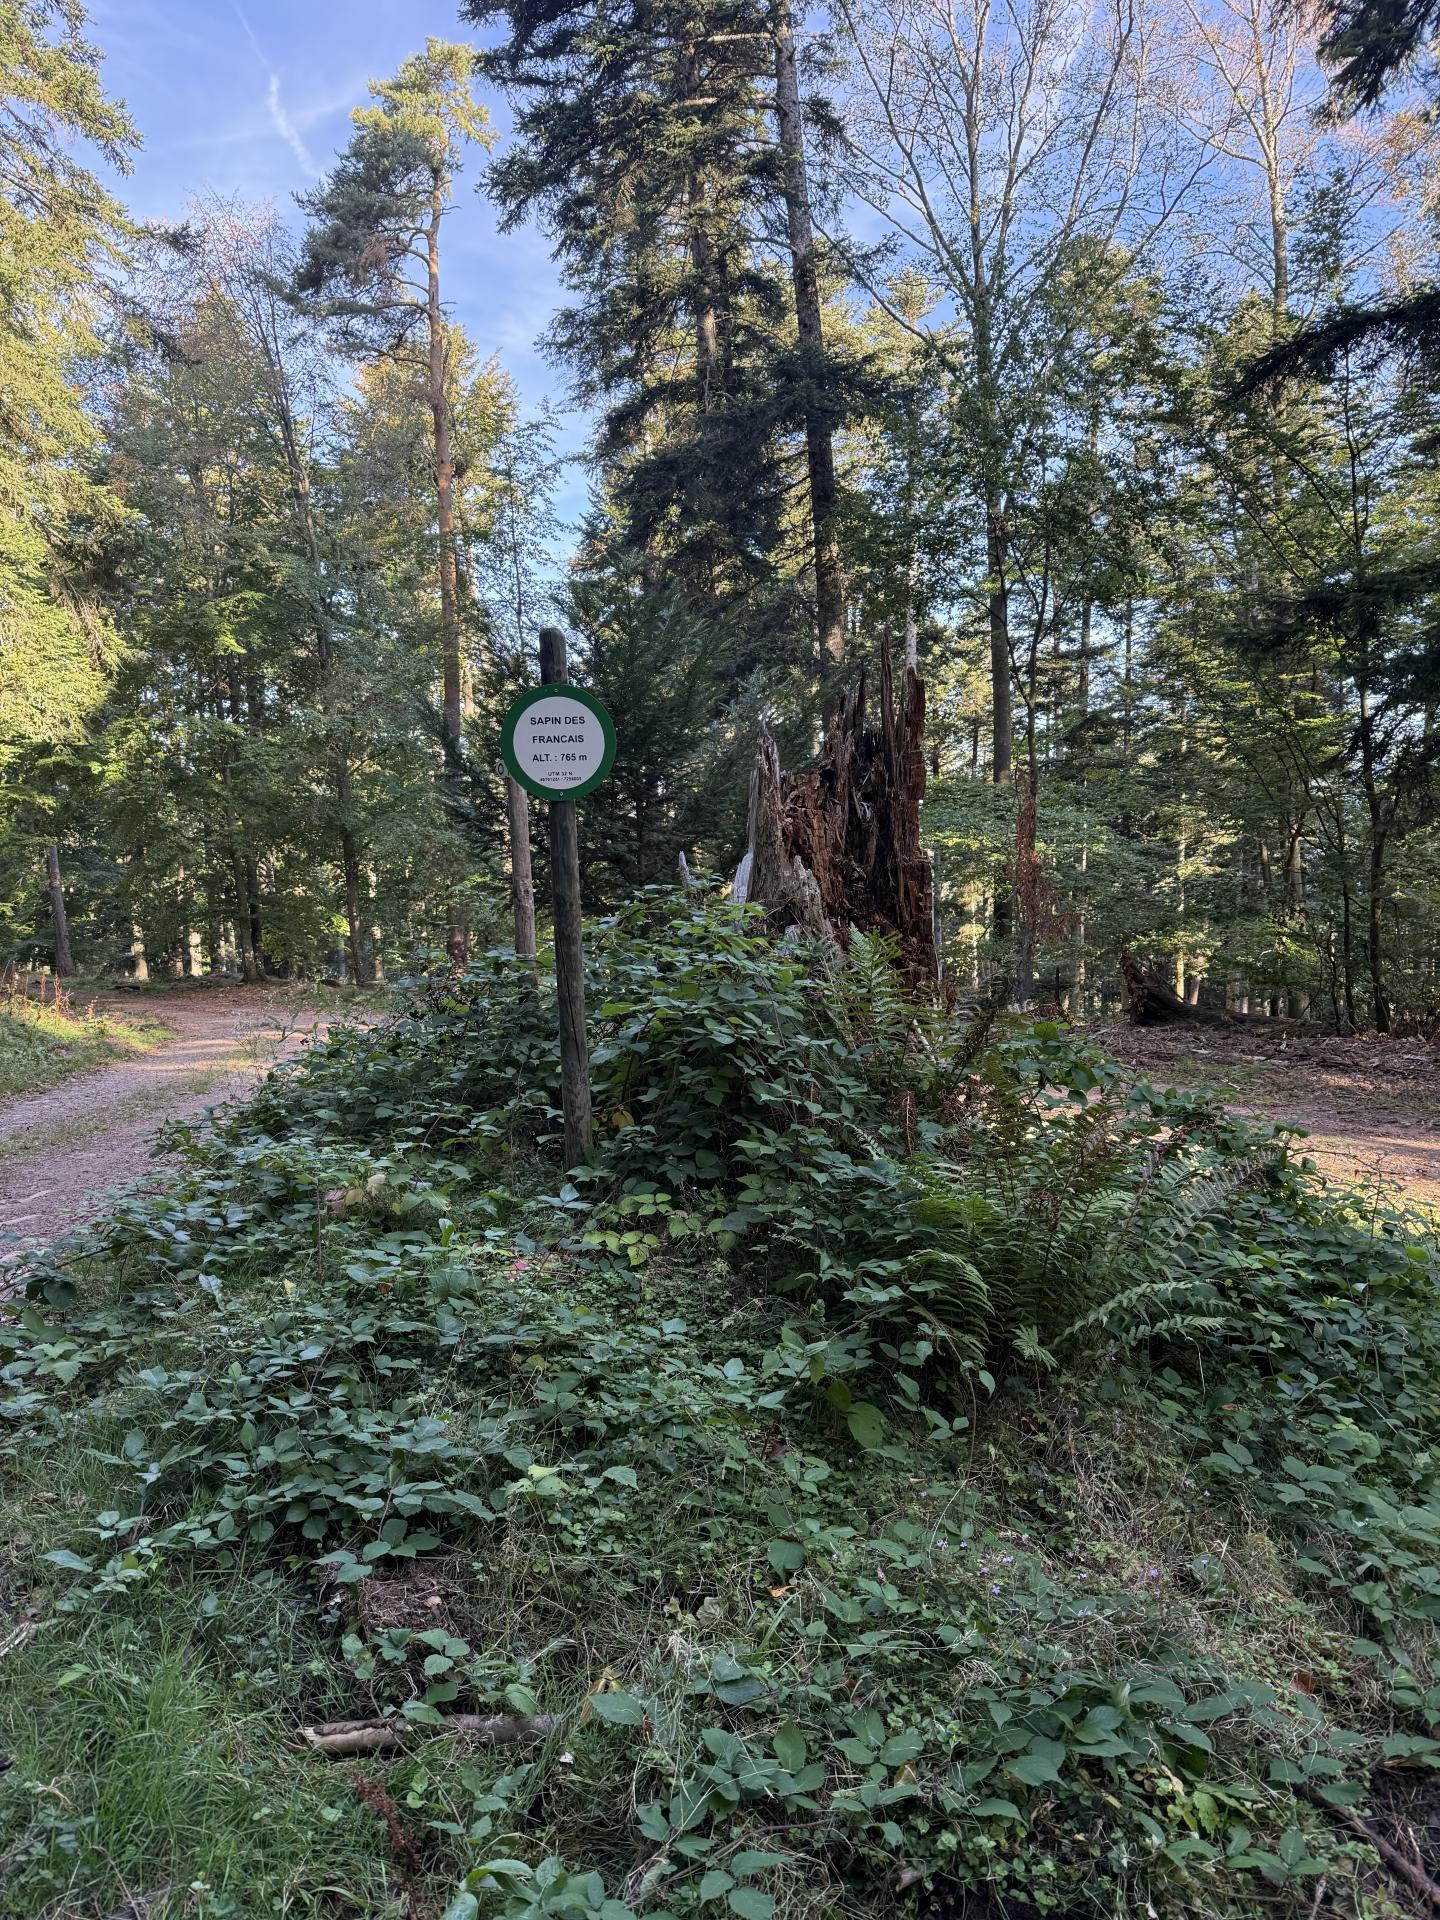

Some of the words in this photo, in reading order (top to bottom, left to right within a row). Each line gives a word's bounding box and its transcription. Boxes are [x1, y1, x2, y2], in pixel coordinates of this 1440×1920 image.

[530, 717, 561, 725] SAPIN
[565, 716, 585, 724] DES
[533, 735, 584, 743] FRANCAIS
[533, 753, 551, 762] ALT.
[561, 753, 576, 761] 765
